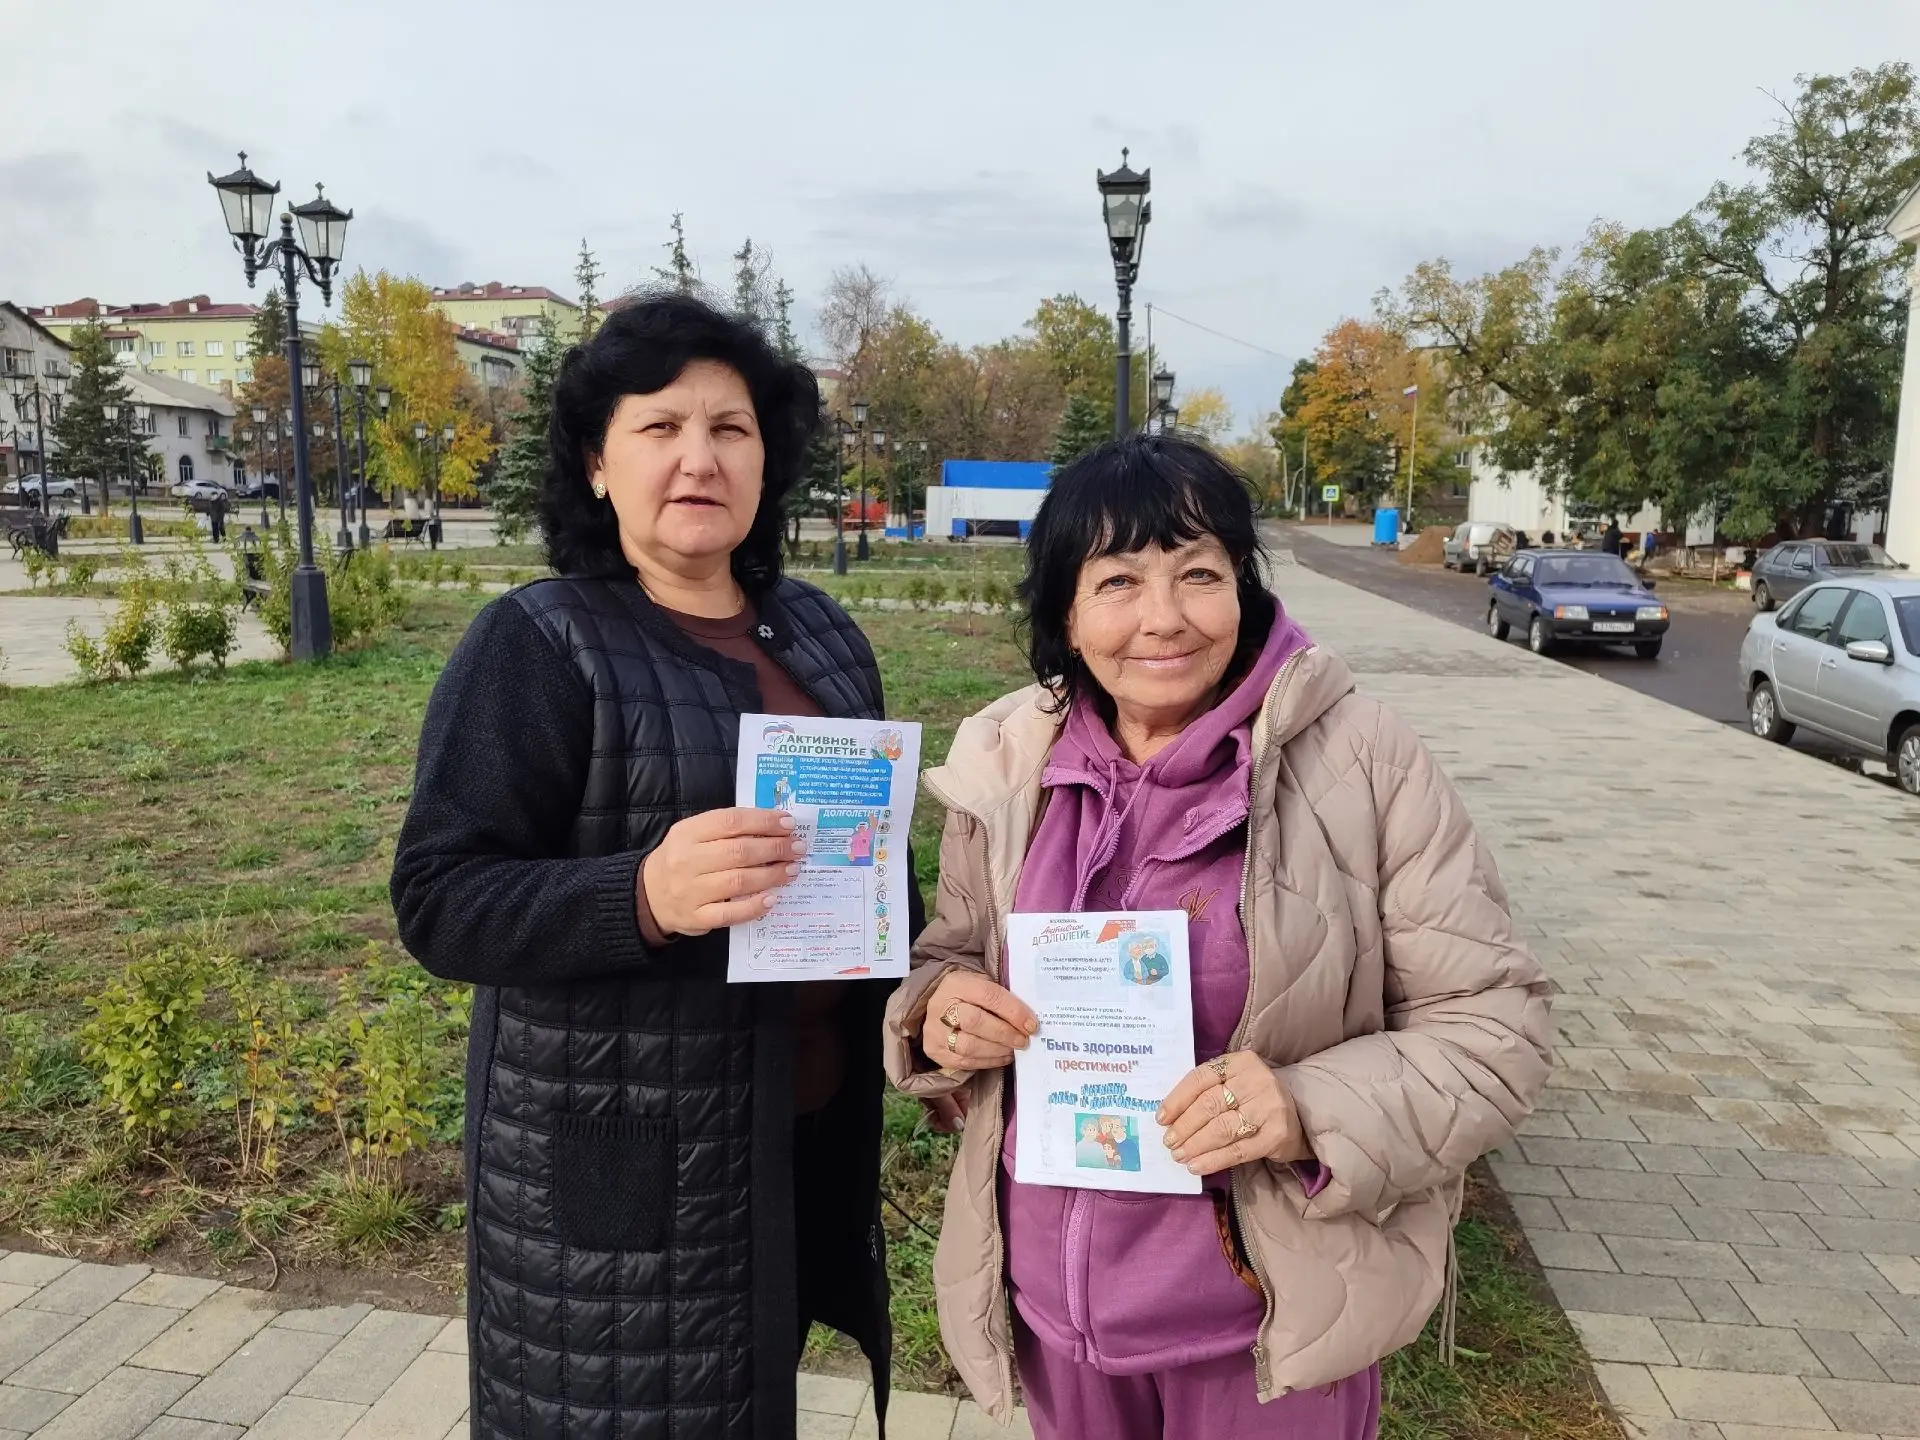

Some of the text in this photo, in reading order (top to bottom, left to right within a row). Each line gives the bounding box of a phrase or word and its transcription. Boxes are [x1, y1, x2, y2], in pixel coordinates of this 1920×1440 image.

[786, 734, 857, 746] АКТИВНОЕ
[777, 744, 867, 756] ДОЛГОЛЕТИЕ
[823, 809, 880, 818] ДОЛГОЛЕТИЕ
[1032, 929, 1091, 946] ДОЛГОЛЕТИЕ
[1041, 1038, 1153, 1057] "Быть здоровым
[1054, 1059, 1139, 1073] престижно!"
